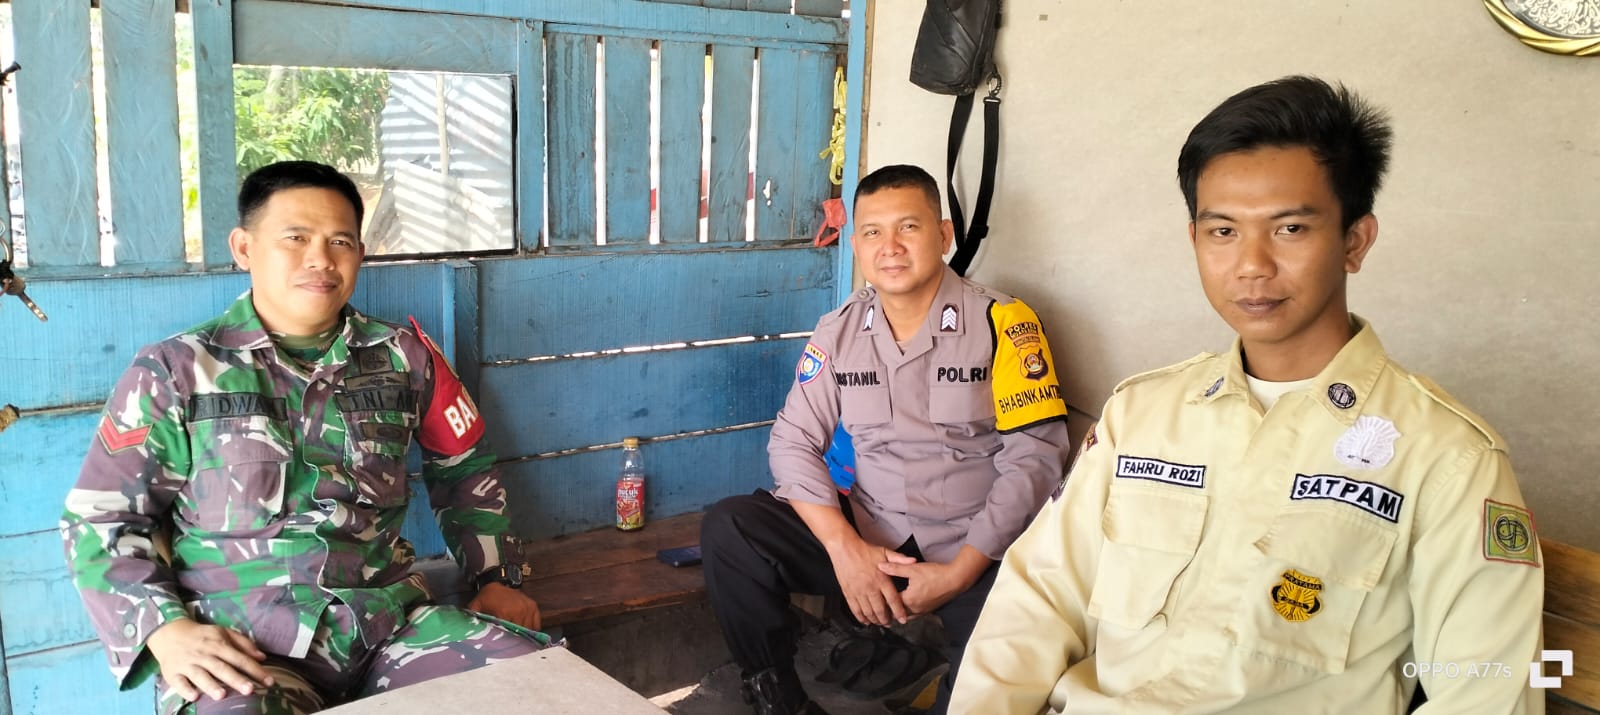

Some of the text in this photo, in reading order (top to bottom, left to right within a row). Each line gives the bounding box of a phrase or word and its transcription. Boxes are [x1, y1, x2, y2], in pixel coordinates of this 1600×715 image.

[937, 366, 988, 383] POLRI
[197, 395, 275, 418] RIDWA
[347, 390, 385, 409] TNI
[1123, 461, 1201, 482] FAHRU ROZI
[1297, 478, 1398, 518] SATPAM
